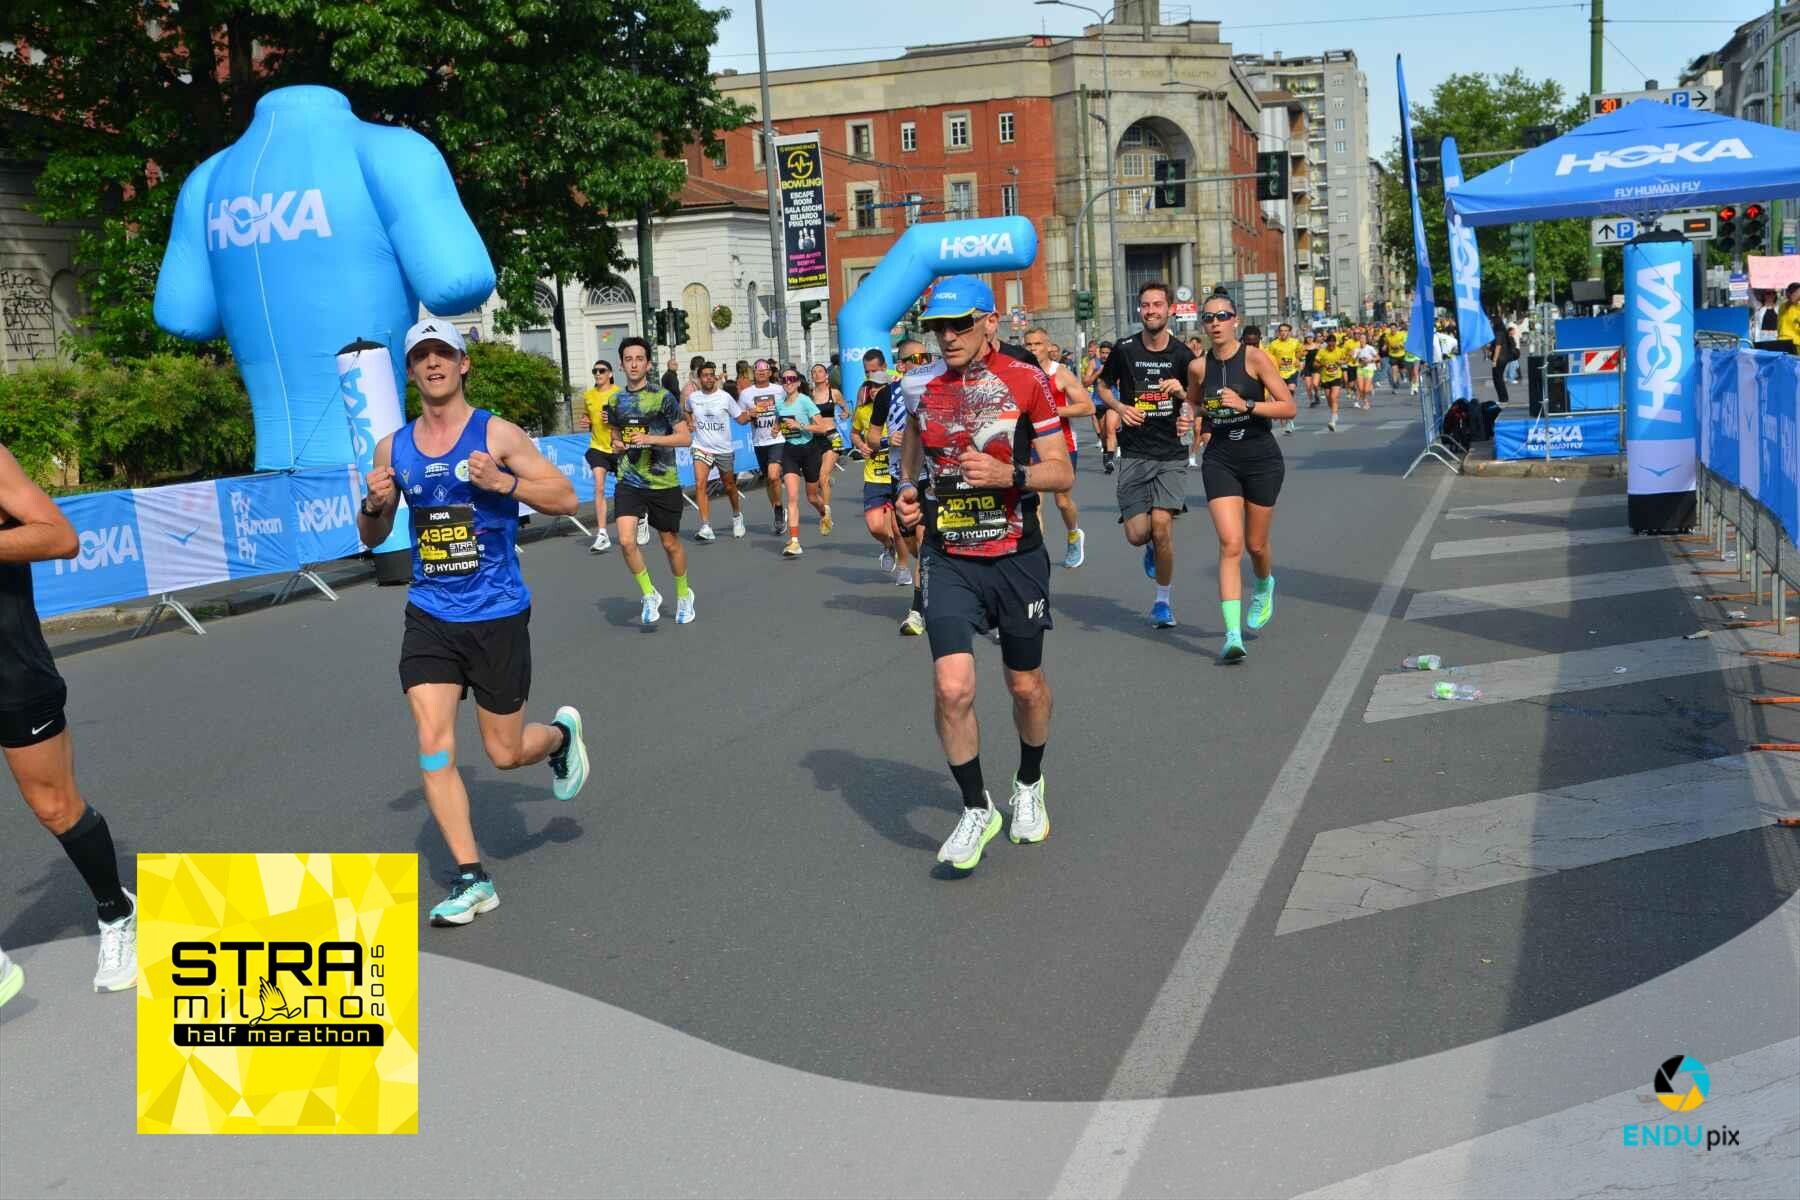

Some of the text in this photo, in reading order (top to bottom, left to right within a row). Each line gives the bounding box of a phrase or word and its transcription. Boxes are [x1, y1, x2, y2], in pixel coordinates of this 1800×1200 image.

[1601, 99, 1616, 113] 30
[1554, 138, 1753, 176] HOKA
[781, 177, 822, 190] BOWLING
[1614, 180, 1701, 198] FLY HUMAN FLY
[790, 190, 814, 199] ESCAPE
[793, 198, 812, 206] ROOM
[785, 206, 800, 214] SALA
[208, 189, 332, 251] HOKA
[789, 220, 803, 229] PING
[940, 232, 1014, 260] HOKA
[935, 291, 957, 301] HOKA
[1176, 303, 1195, 311] KFC
[1636, 260, 1682, 424] HOKA
[697, 421, 725, 432] GUIDE
[1527, 425, 1583, 443] HOKA
[296, 495, 353, 535] HOKA
[430, 512, 450, 521] HOKA
[234, 513, 282, 537] Human
[421, 526, 467, 543] 4320
[437, 560, 479, 572] HYUNDAI
